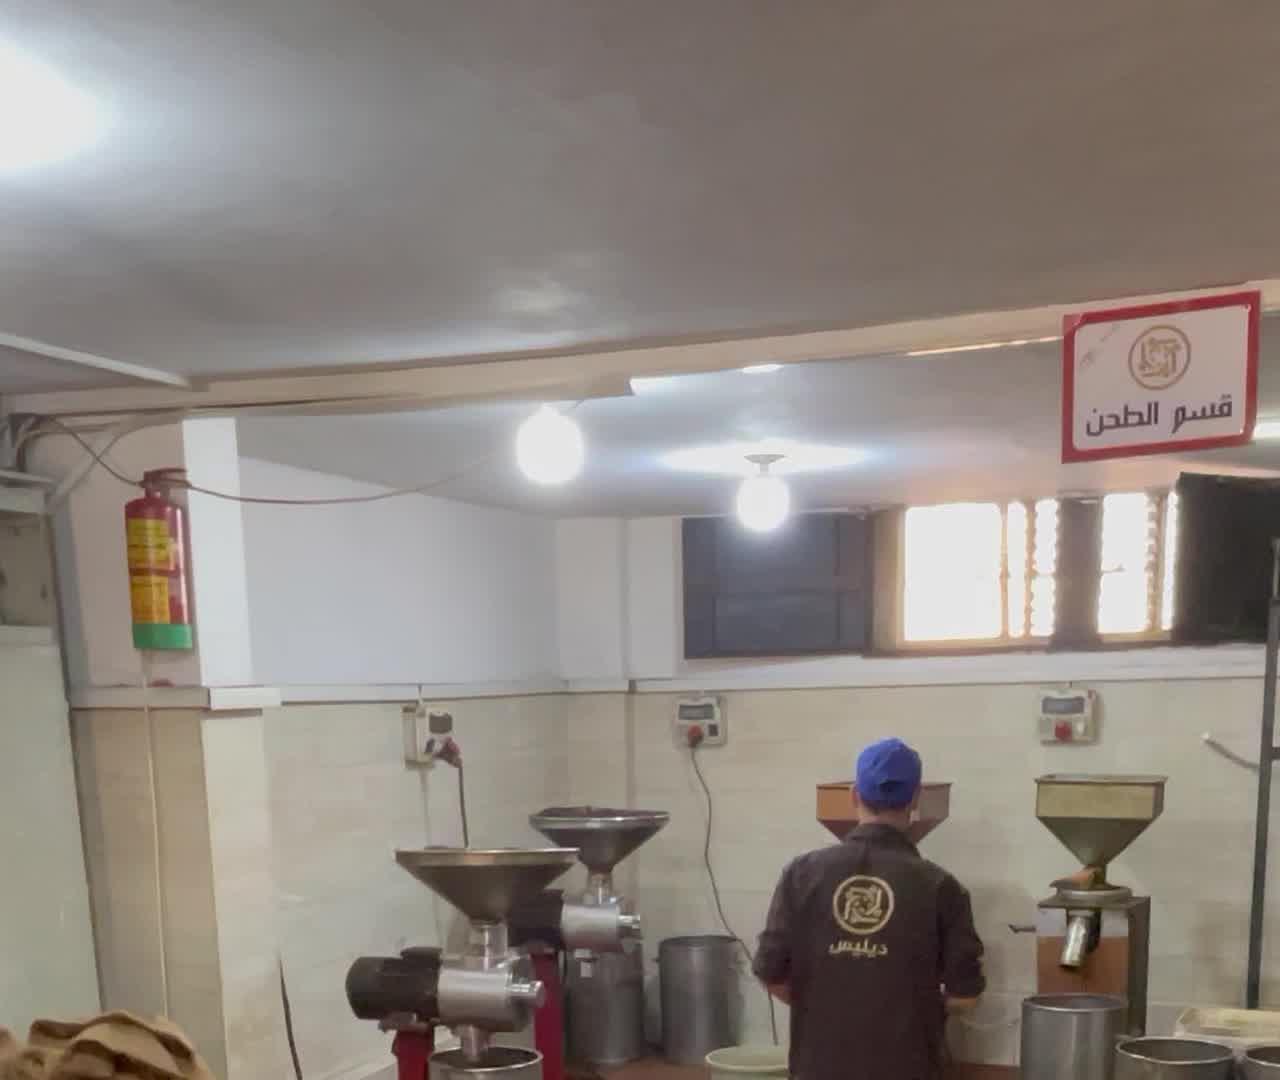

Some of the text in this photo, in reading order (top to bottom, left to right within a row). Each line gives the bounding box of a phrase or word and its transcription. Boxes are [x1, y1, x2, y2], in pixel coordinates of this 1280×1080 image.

[1086, 394, 1233, 437] قسم الطحن
[828, 938, 889, 958] ديليس
